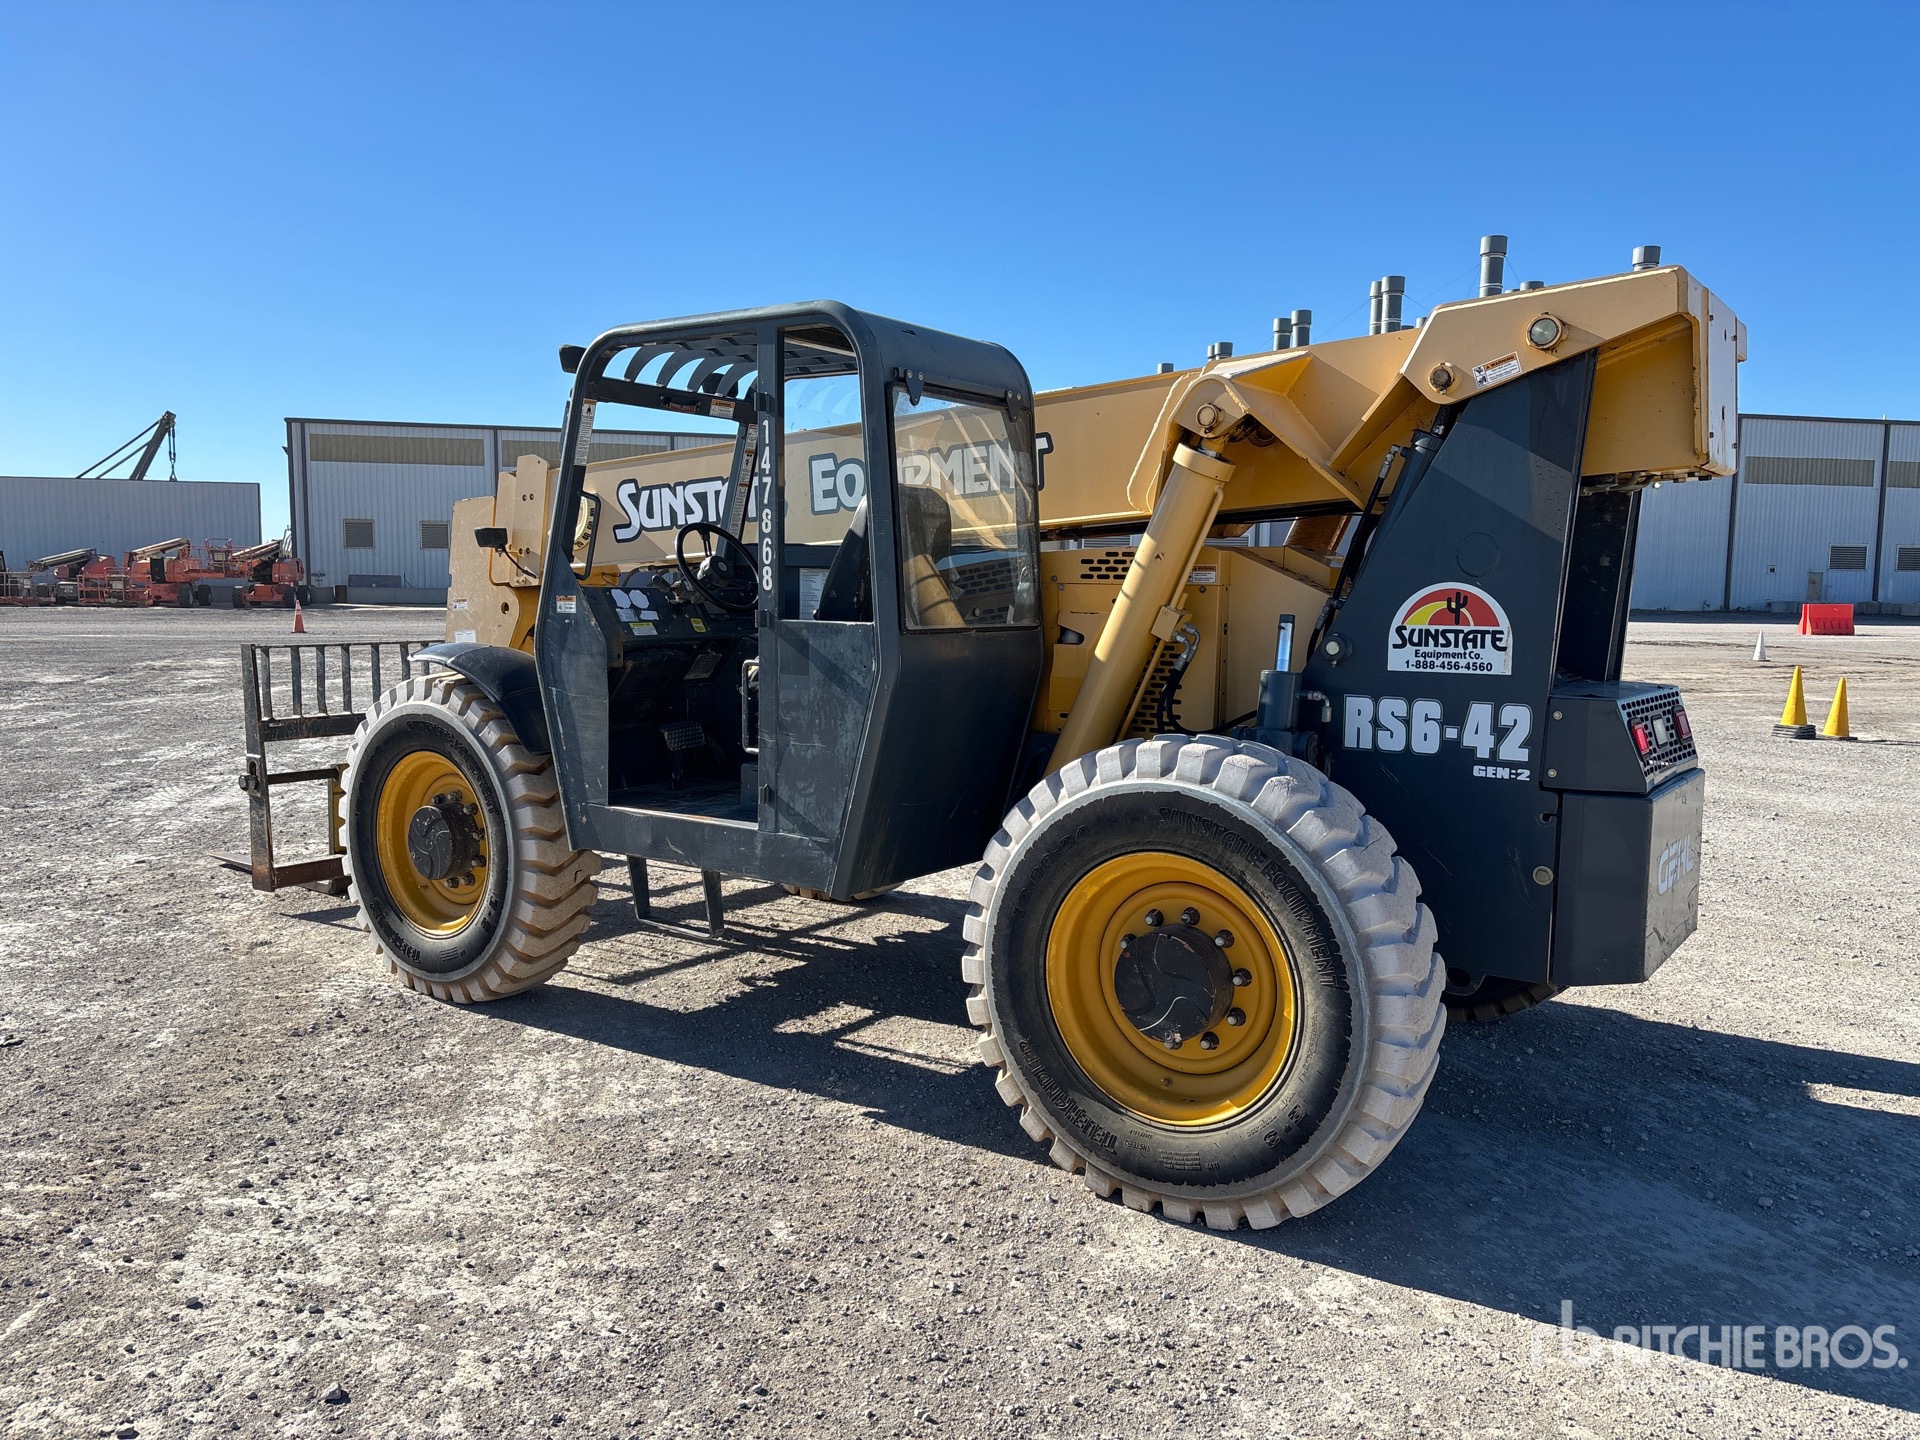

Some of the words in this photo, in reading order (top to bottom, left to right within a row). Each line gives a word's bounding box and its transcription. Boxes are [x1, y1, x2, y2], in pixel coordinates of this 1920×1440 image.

[1392, 625, 1507, 652] SUNSTATE
[1414, 649, 1467, 660] Equipment
[1468, 650, 1483, 660] Co.
[1404, 659, 1493, 672] 1-888-456-4560
[1343, 695, 1532, 762] RS6-42
[1472, 765, 1531, 781] GEN:2
[1158, 806, 1264, 869] SUNSTATE
[1261, 858, 1347, 990] EQUIPMENT
